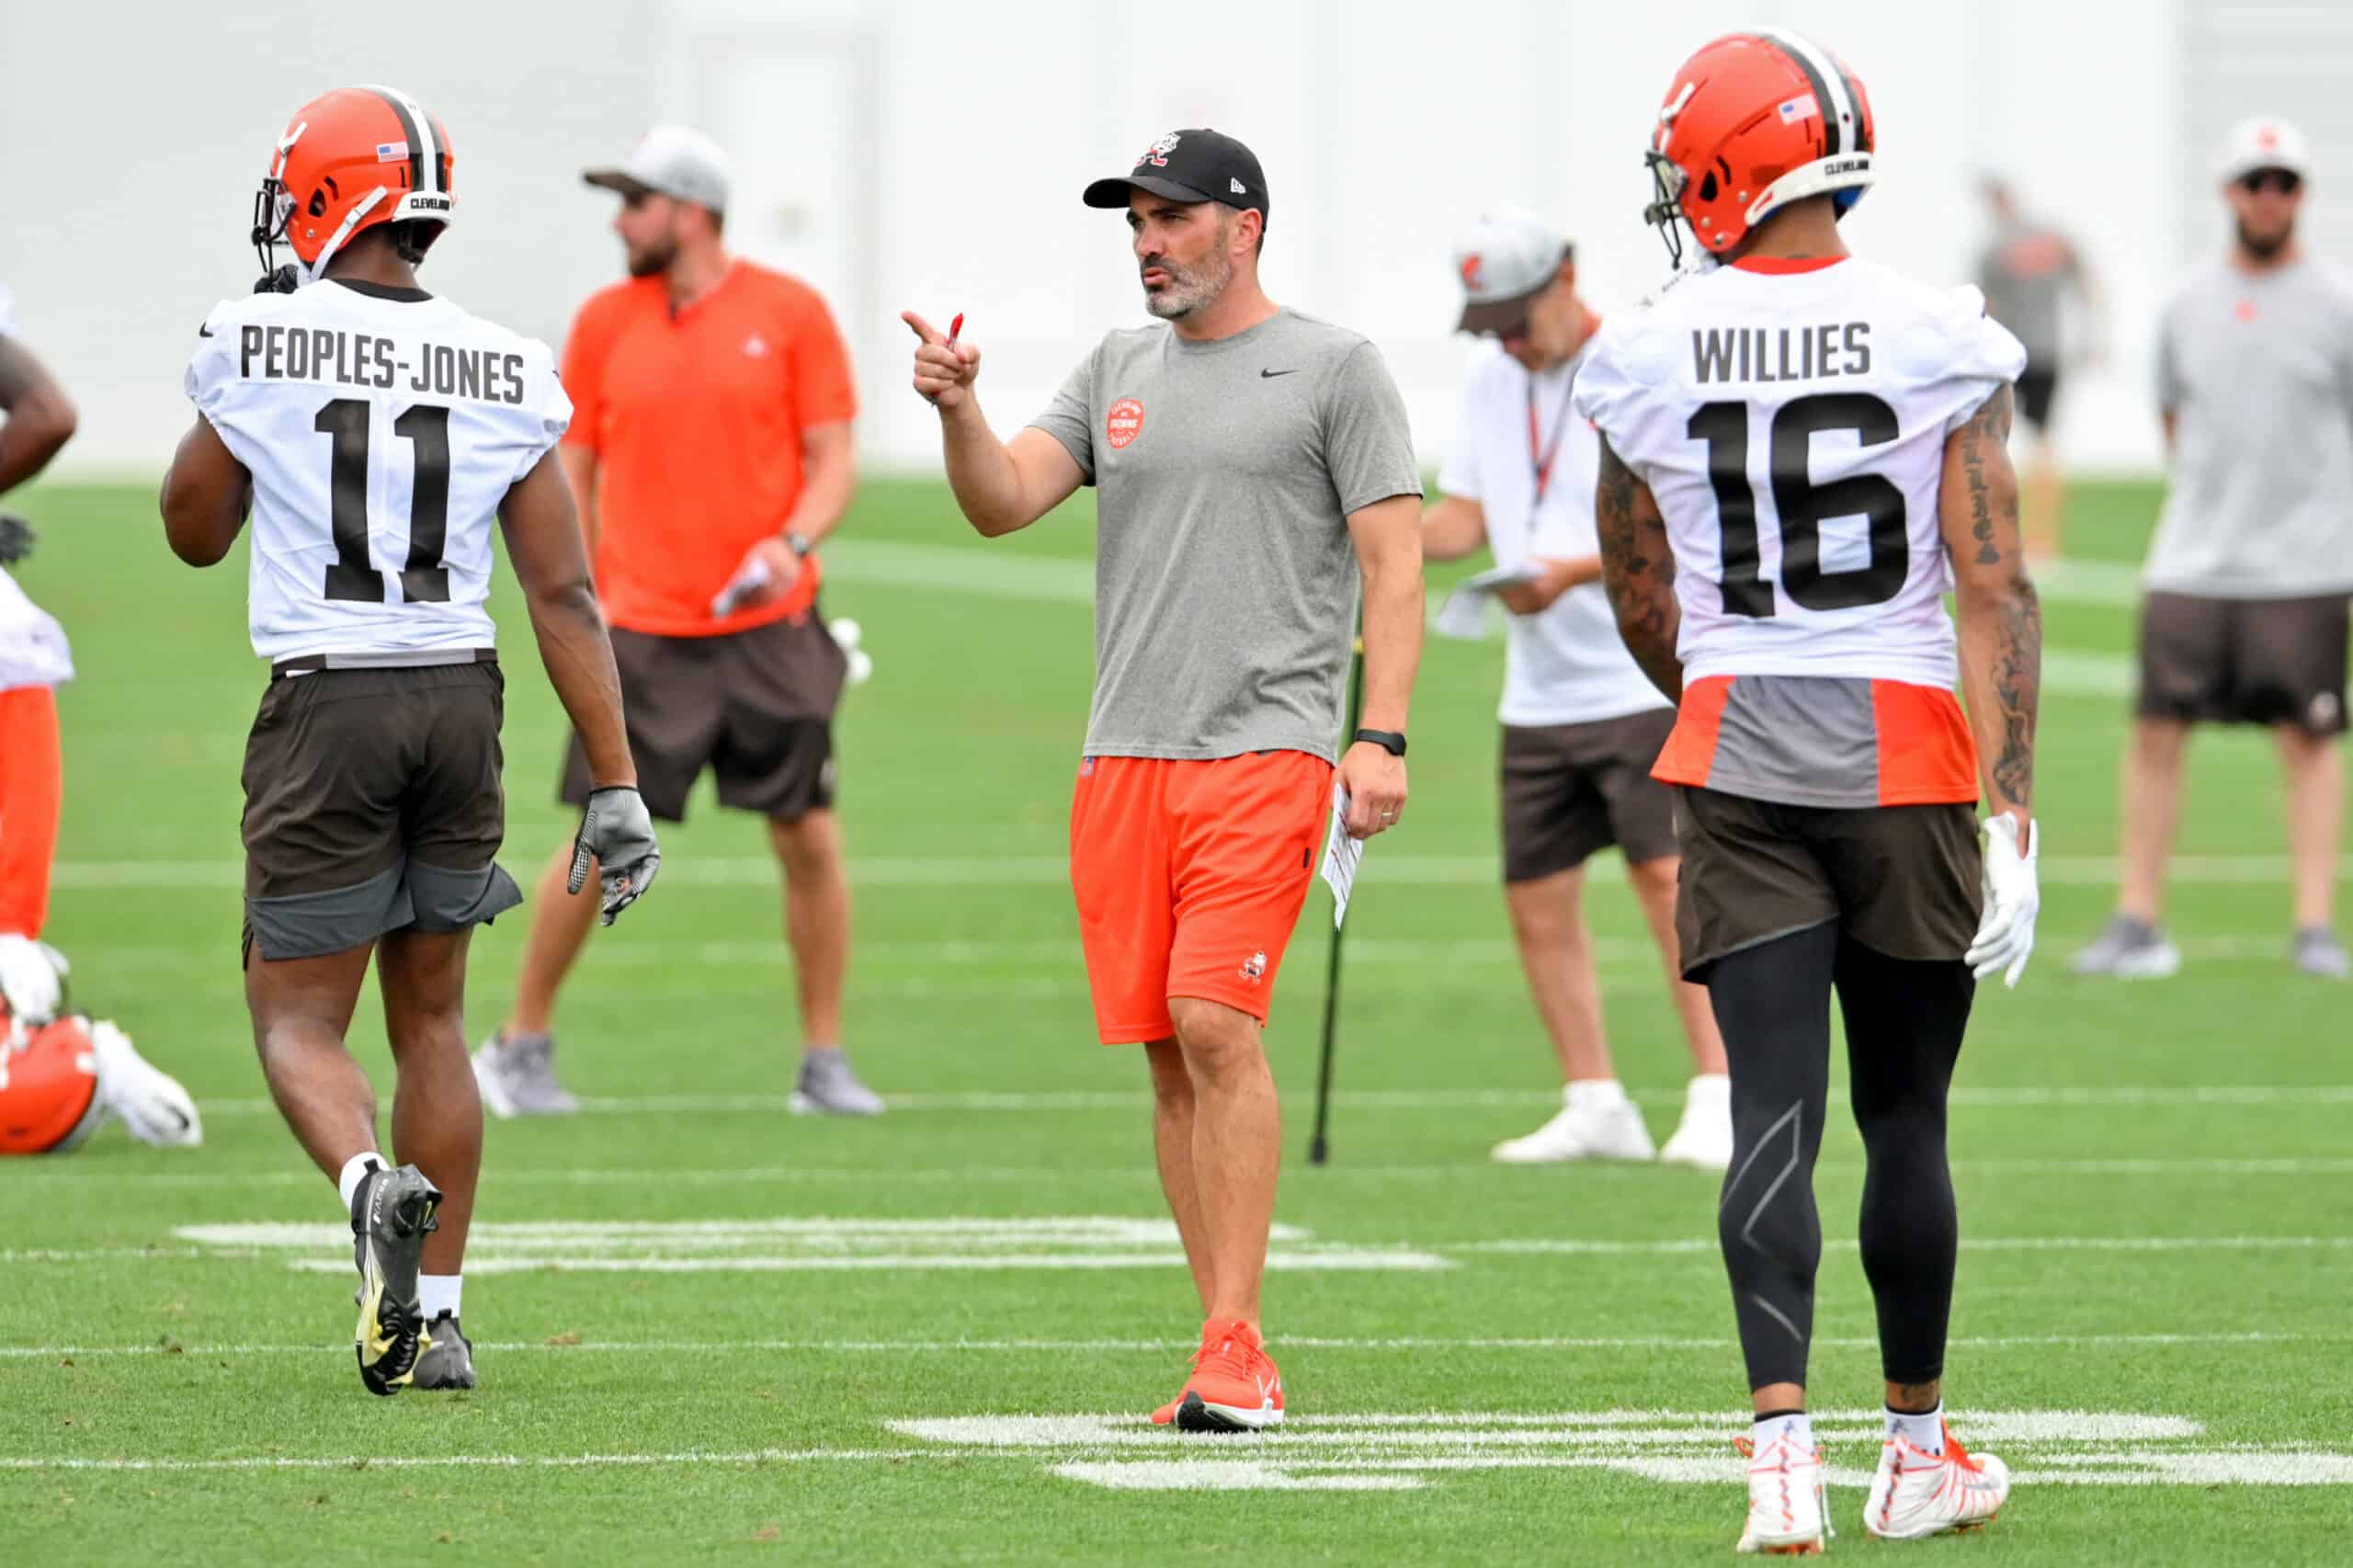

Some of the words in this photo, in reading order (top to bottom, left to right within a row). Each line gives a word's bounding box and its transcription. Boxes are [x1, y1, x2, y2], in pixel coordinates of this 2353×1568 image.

[240, 325, 524, 404] PEOPLES-JONES
[1692, 322, 1871, 383] WILLIES
[314, 398, 450, 603] 11
[1687, 392, 1909, 618] 16
